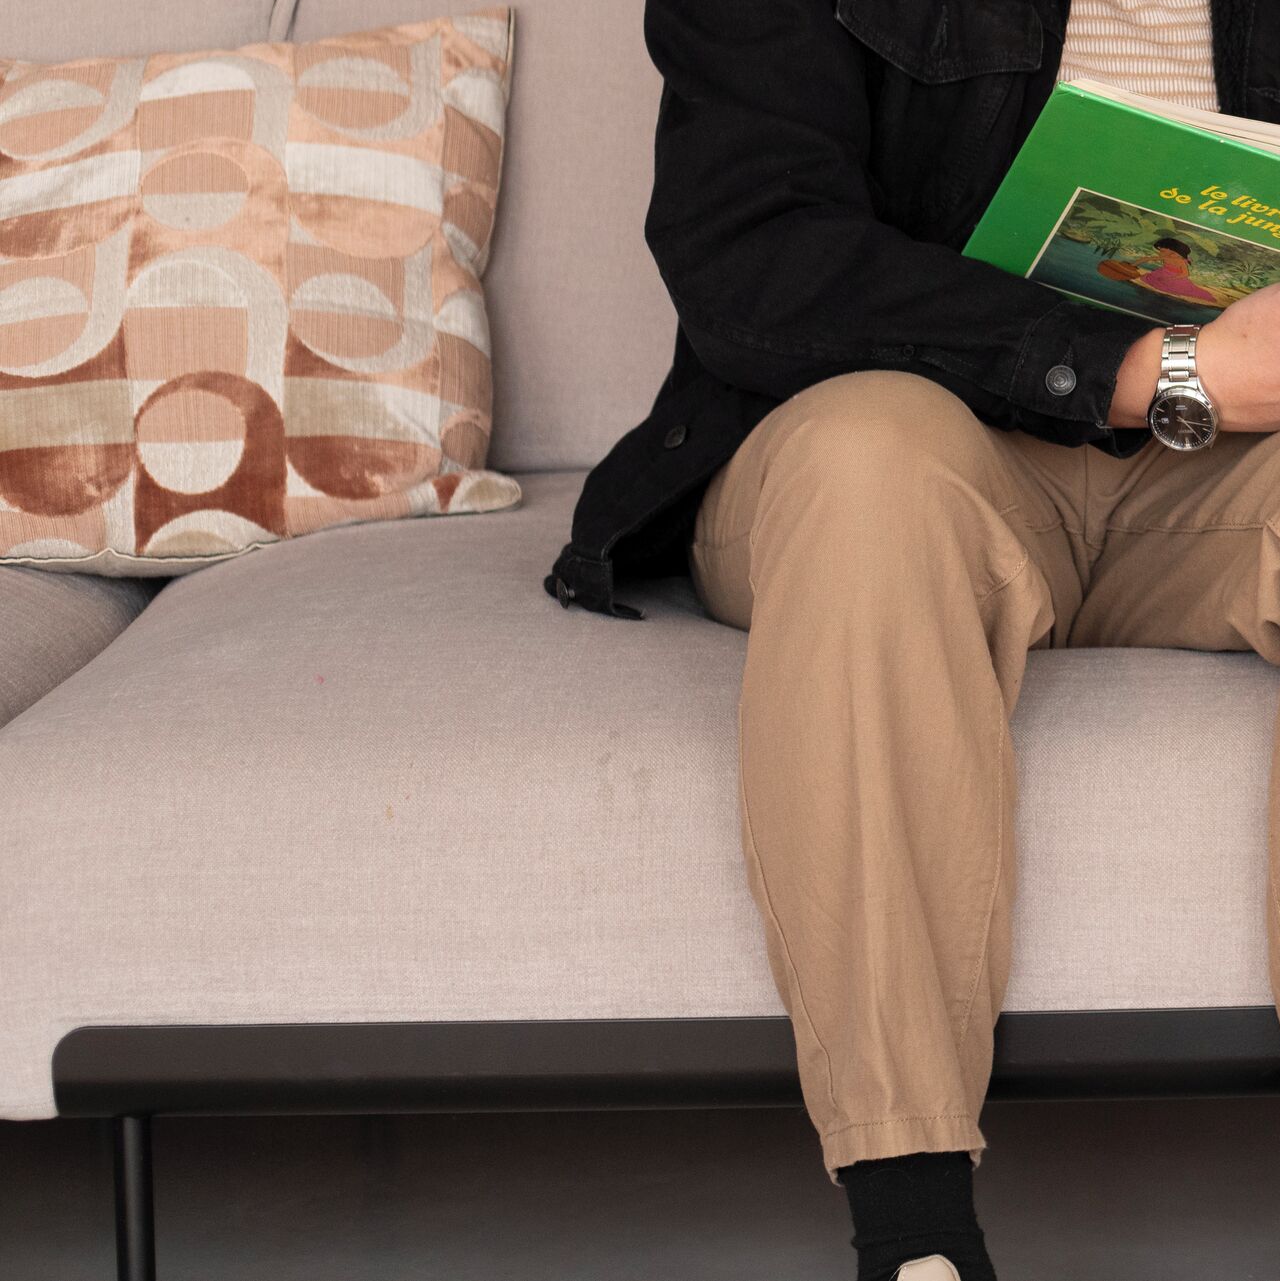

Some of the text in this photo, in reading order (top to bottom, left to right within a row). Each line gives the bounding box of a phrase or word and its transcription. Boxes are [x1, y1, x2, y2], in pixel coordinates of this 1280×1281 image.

[1159, 187, 1193, 206] de
[1198, 200, 1228, 217] la
[1200, 185, 1227, 201] le
